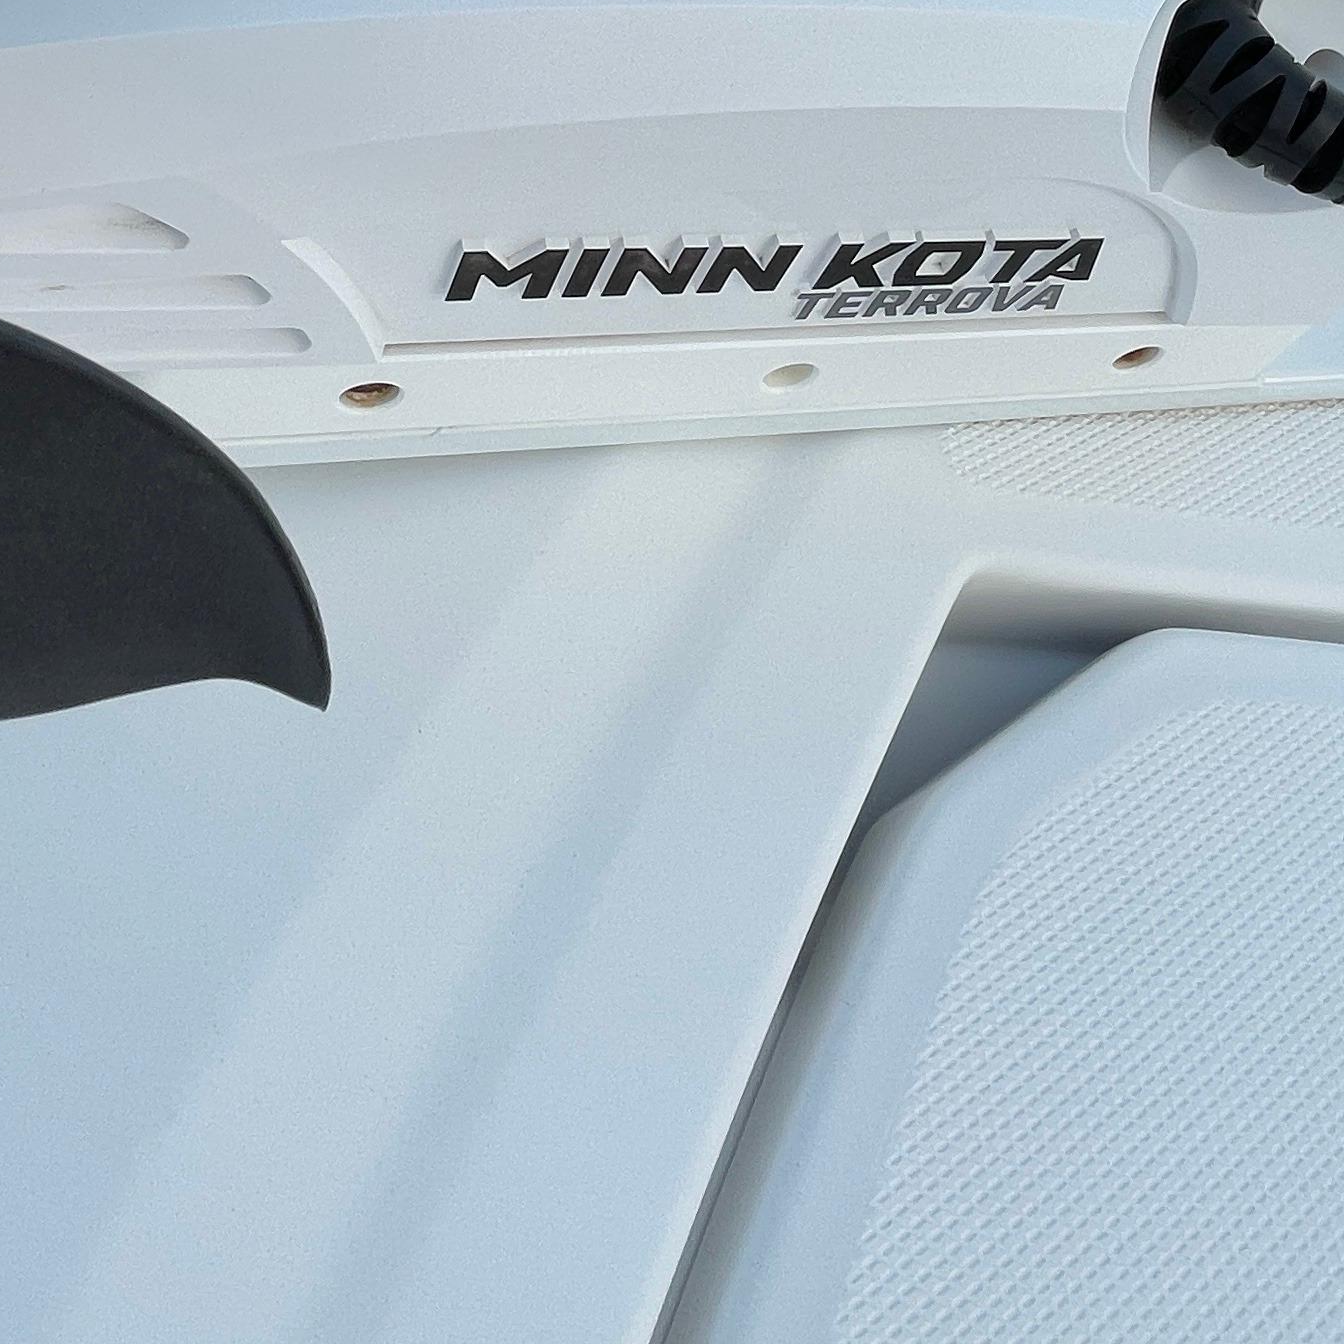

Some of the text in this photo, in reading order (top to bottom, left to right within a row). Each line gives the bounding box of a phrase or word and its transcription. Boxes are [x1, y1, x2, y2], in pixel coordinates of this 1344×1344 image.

[444, 236, 1105, 302] MINN KOTA
[794, 283, 1066, 321] TERROVA
